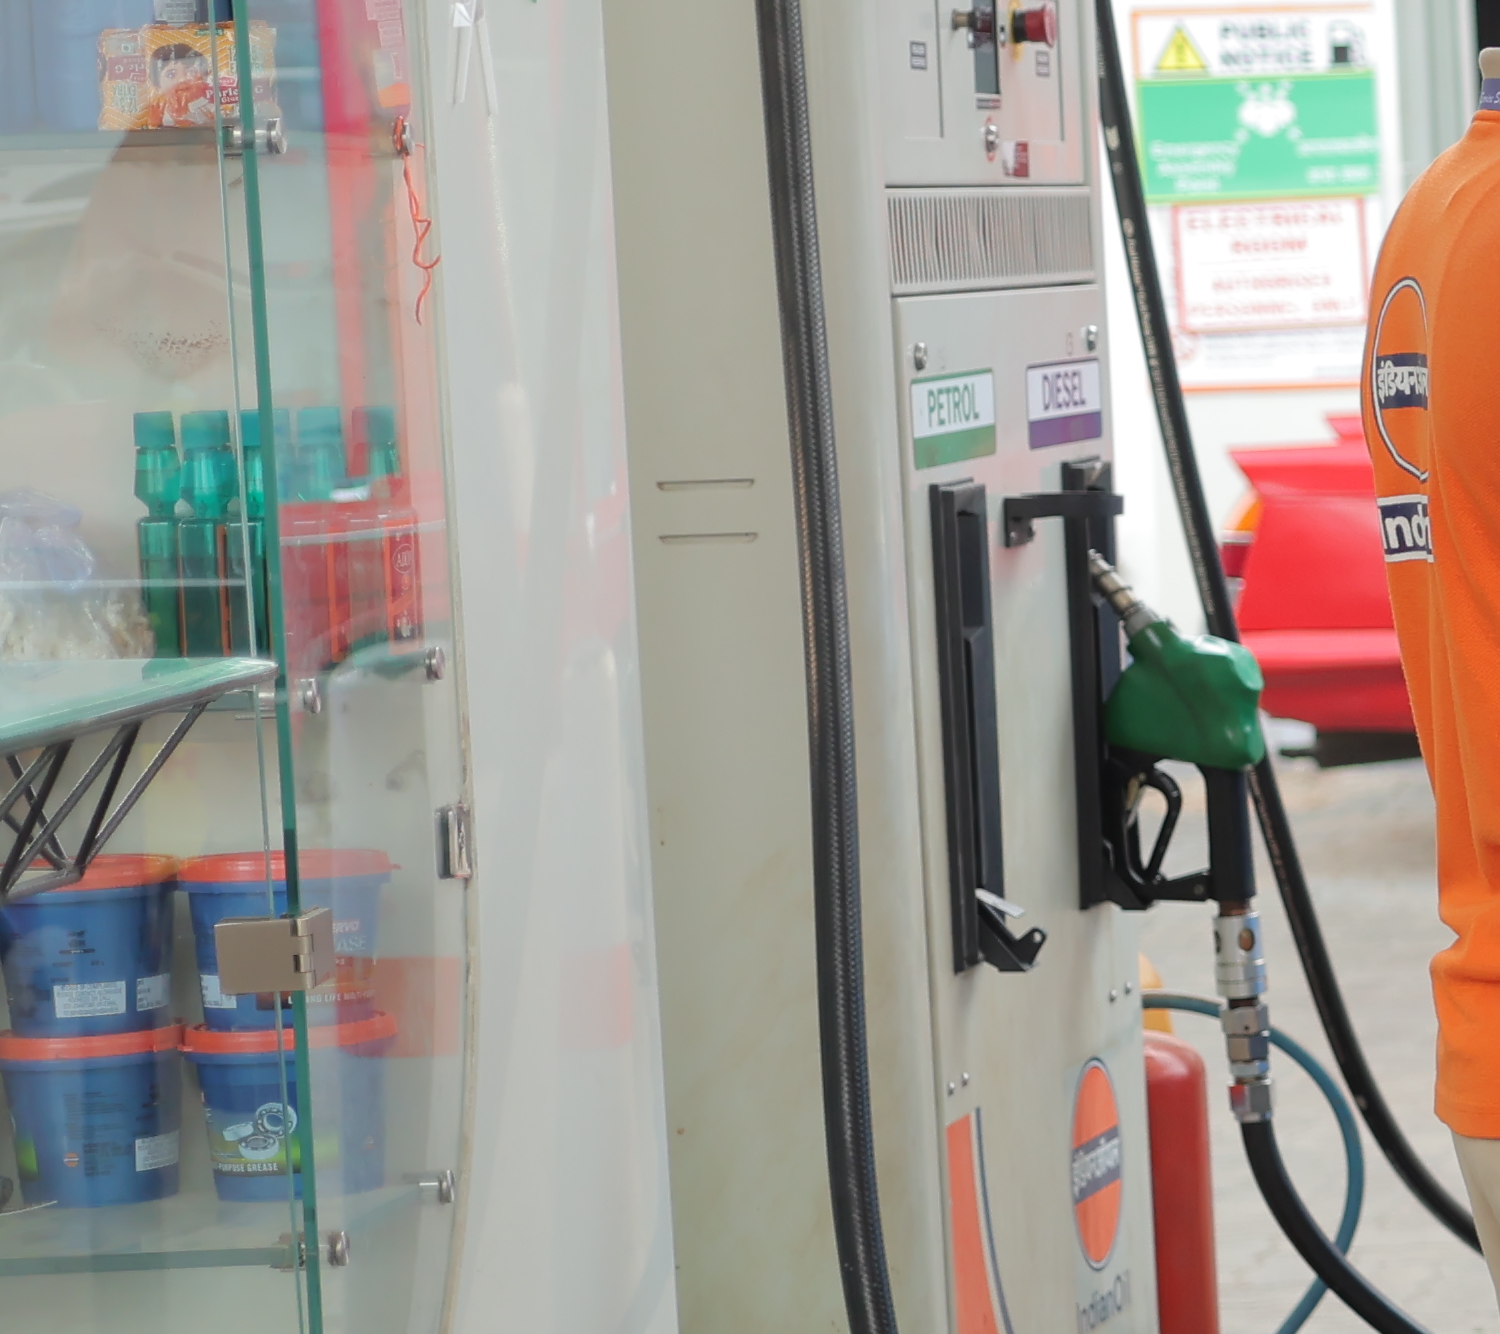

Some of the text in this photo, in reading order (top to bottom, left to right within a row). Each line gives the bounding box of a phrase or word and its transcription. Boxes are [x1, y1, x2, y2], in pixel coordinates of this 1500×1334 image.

[926, 382, 980, 430] PETROL
[1041, 369, 1087, 413] DIESEL
[246, 1162, 279, 1173] GREASE
